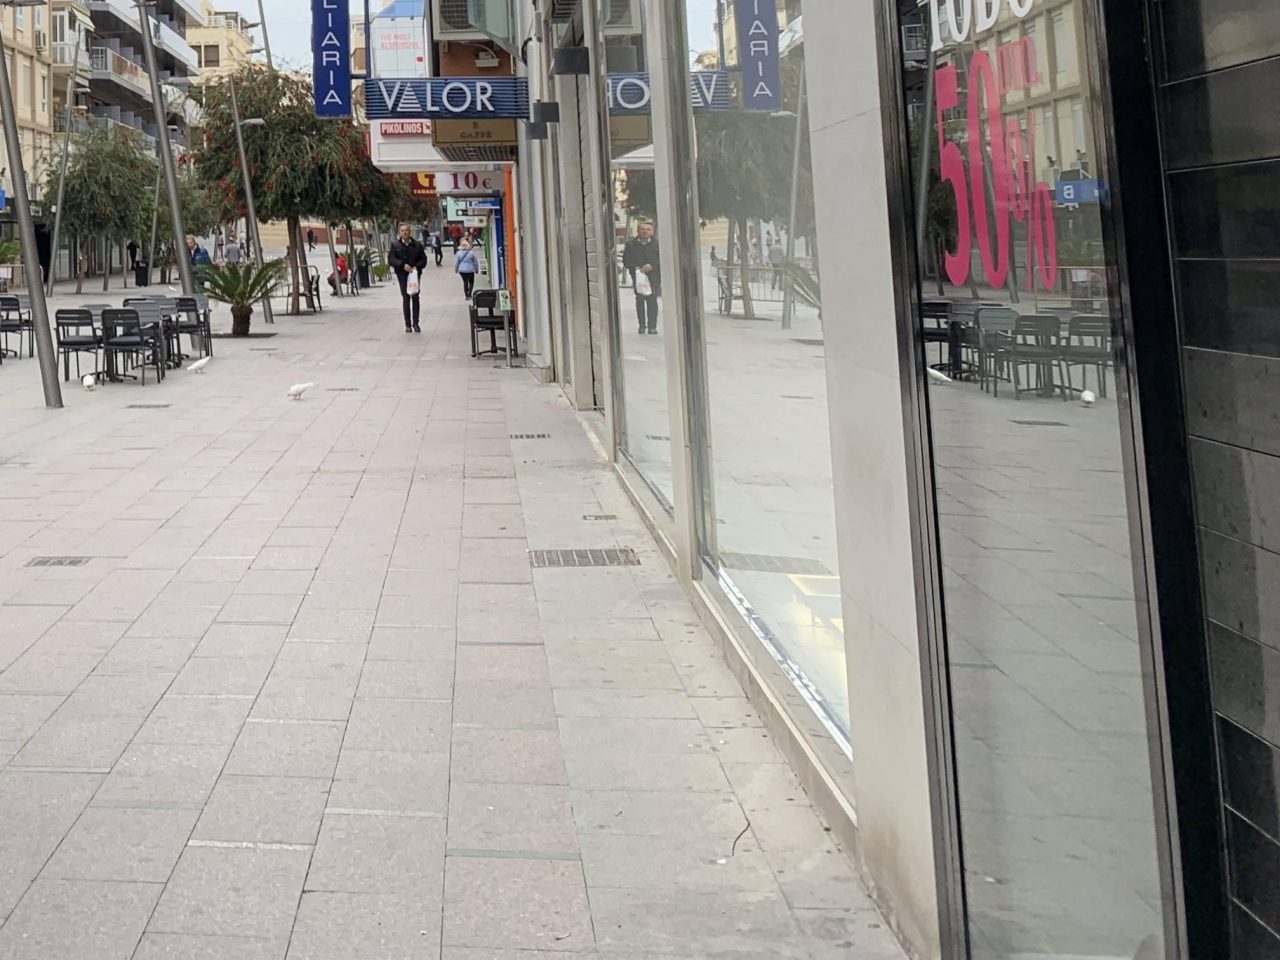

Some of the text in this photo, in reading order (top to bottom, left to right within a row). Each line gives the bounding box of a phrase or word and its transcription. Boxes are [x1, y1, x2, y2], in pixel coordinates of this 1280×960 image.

[378, 81, 495, 112] VALOR
[381, 123, 422, 134] PIKOLINOS
[450, 171, 479, 190] 10
